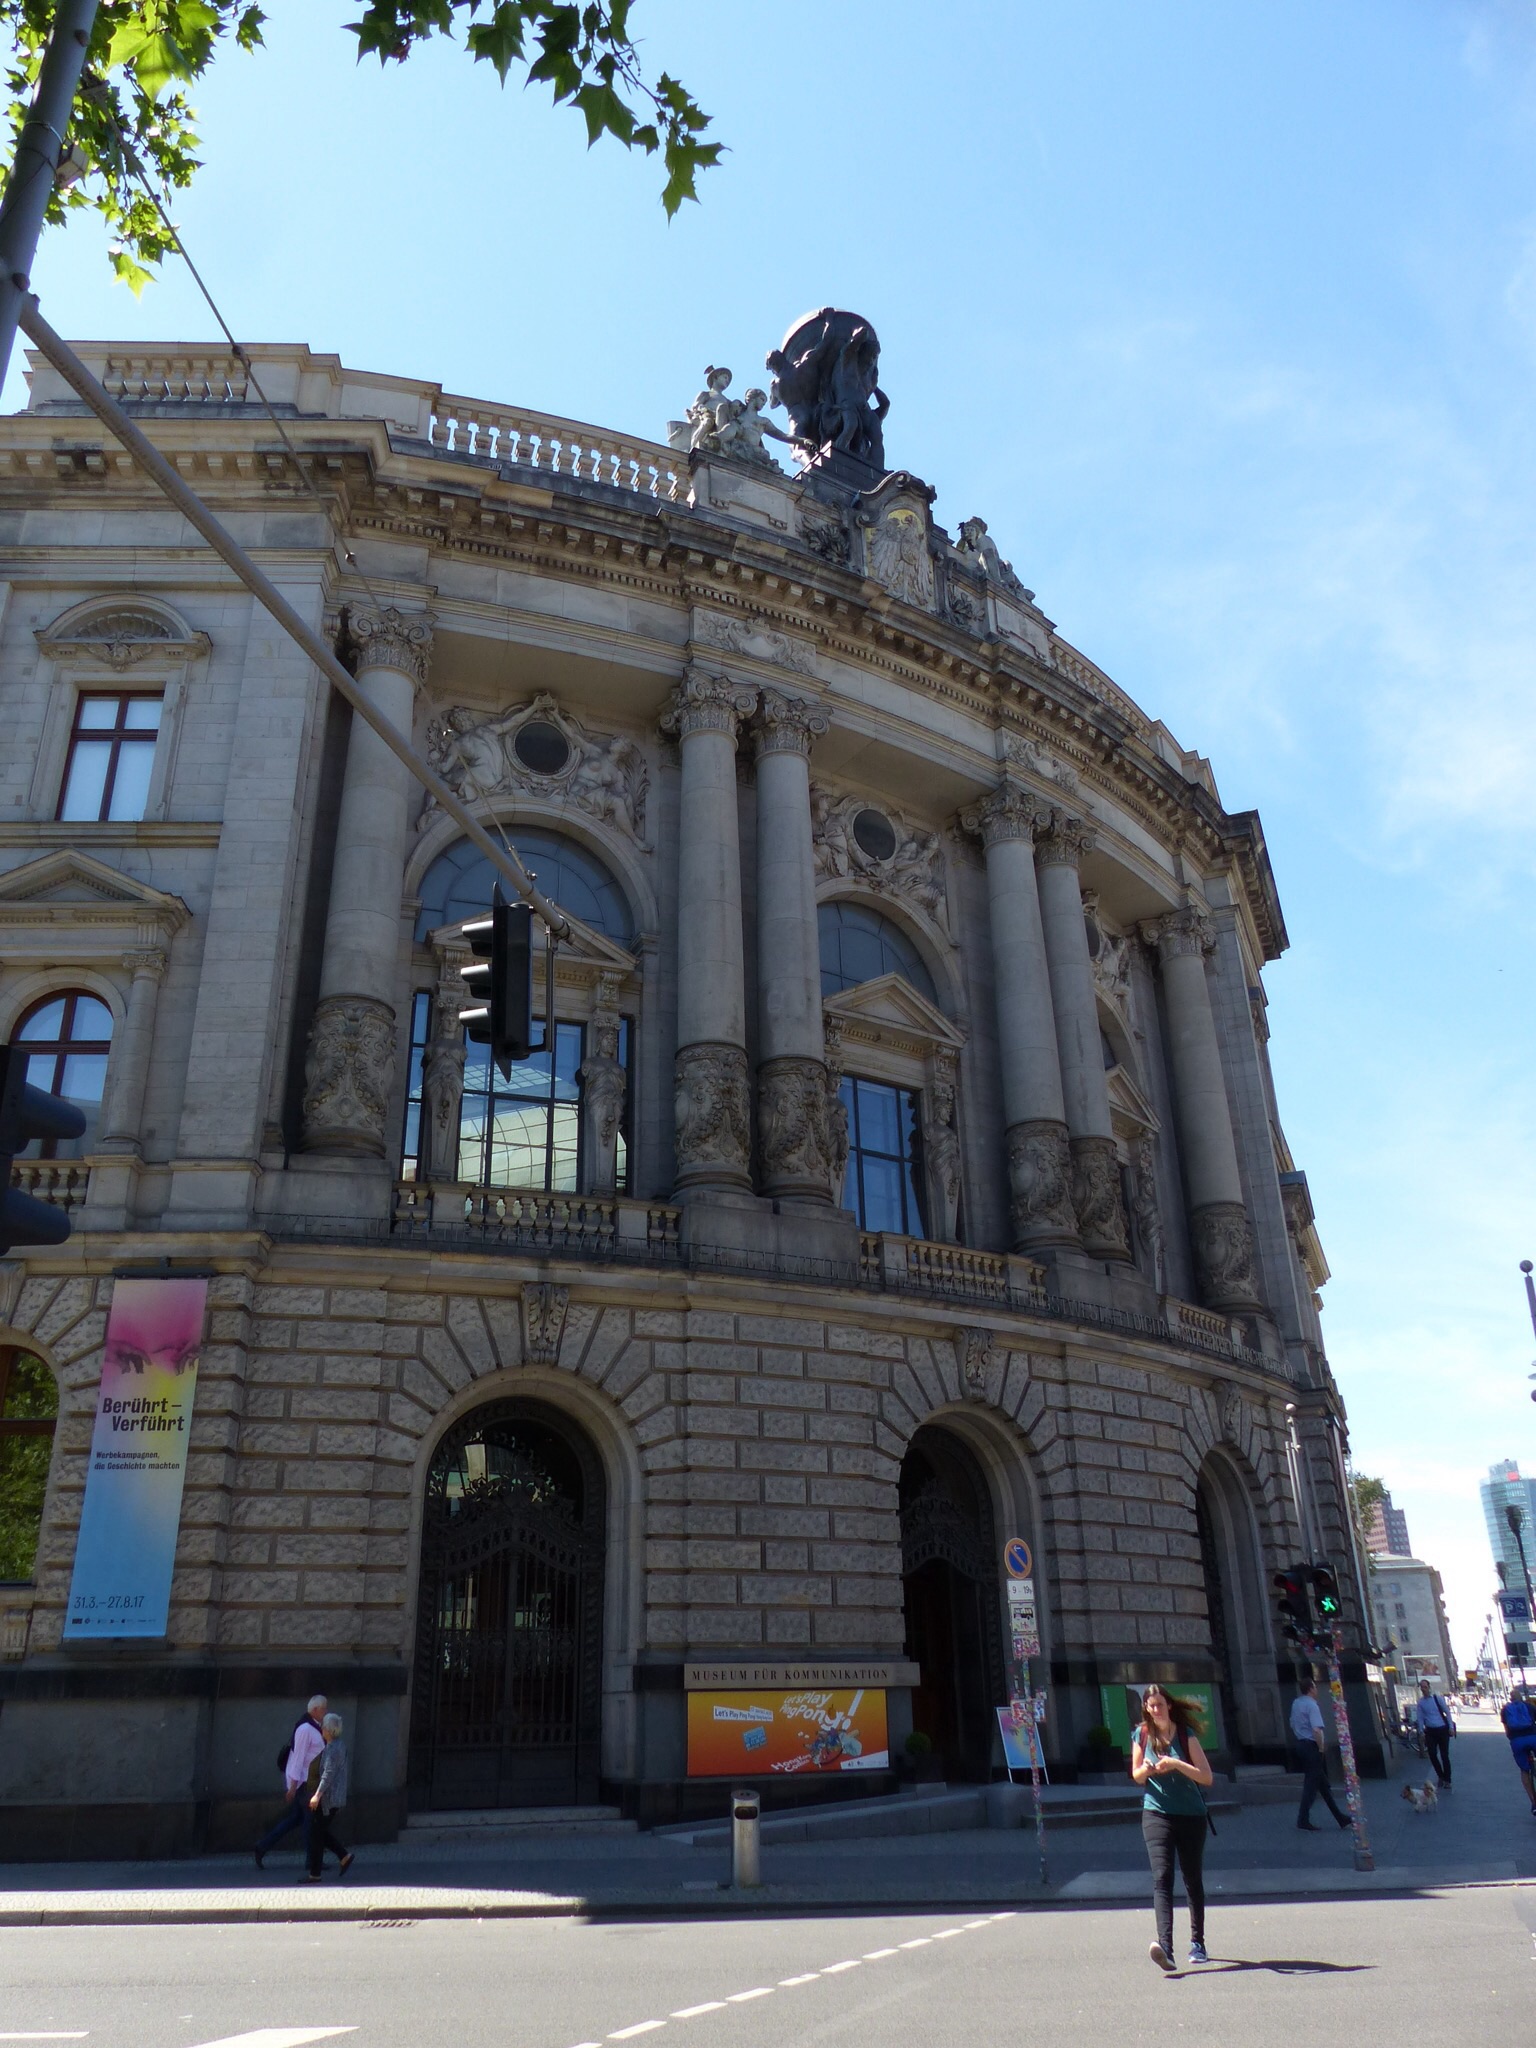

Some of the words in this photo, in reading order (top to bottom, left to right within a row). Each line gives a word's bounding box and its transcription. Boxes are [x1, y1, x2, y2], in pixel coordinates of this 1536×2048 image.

[102, 1397, 168, 1414] Berührt
[112, 1415, 185, 1431] Verführt
[96, 1451, 160, 1460] Werbekampagnen,
[94, 1462, 105, 1470] die
[107, 1462, 146, 1470] Geschichte
[148, 1462, 180, 1470] machten
[1012, 1586, 1017, 1594] 9
[692, 1670, 748, 1681] MUSEUM
[753, 1667, 778, 1681] FÜR
[784, 1668, 889, 1680] KOMMUNIKATION
[783, 1695, 802, 1704] Let's
[799, 1691, 834, 1708] Play
[714, 1708, 729, 1717] Let's
[779, 1703, 799, 1719] Ping
